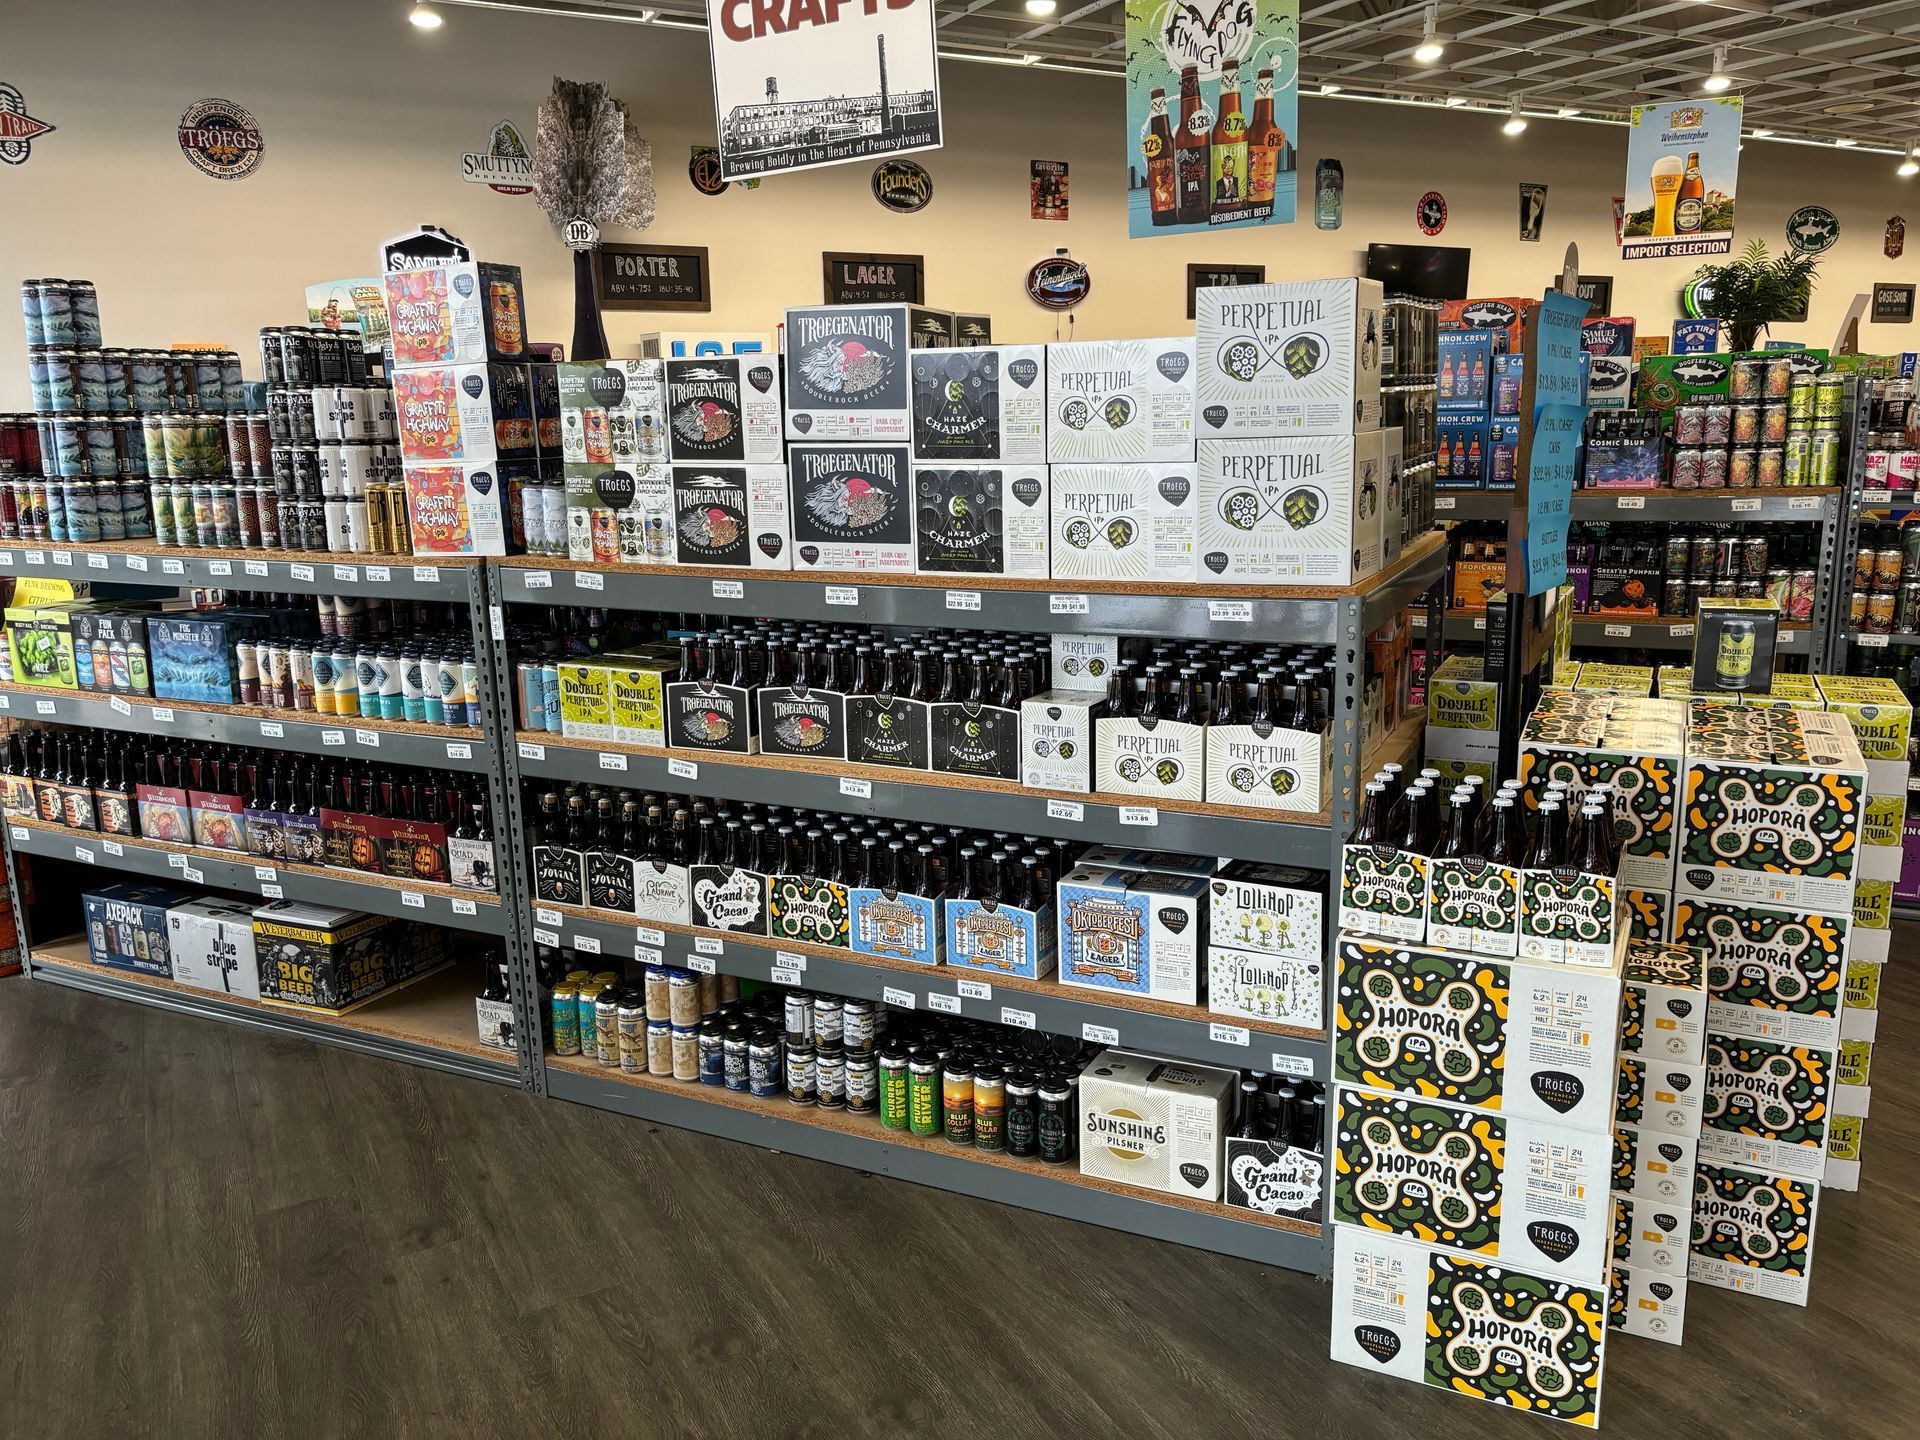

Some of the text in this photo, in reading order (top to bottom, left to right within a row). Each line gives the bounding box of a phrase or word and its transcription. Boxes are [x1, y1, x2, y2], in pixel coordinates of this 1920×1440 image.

[1167, 2, 1254, 66] FLYING DOG
[189, 104, 250, 128] INDEPENDENT
[6, 114, 38, 137] TRAIL
[184, 126, 260, 151] TRÖEGS
[1660, 130, 1709, 144] Weihenstephan
[730, 131, 932, 173] Brewing Boldly in the Heart of Pennsylvania
[191, 149, 218, 172] CRAFT
[218, 151, 256, 174] BREWERY
[1035, 162, 1065, 173] favorite
[880, 168, 927, 200] Founders
[1254, 205, 1271, 218] BEER
[570, 224, 590, 241] DB
[1626, 242, 1728, 259] IMPORT SELECTION
[615, 256, 680, 278] PORTER
[844, 264, 896, 286] LAGER
[396, 301, 438, 321] GRAFFITI
[1220, 299, 1325, 330] PERPETUAL
[1468, 303, 1514, 314] DOGFISH HEAD
[398, 317, 443, 336] HIGHWAY
[798, 314, 895, 350] TROEGENATOR
[1583, 328, 1618, 341] SAMUEL
[1676, 326, 1716, 336] FAT TIRE
[1264, 334, 1280, 345] IPA
[1585, 336, 1614, 345] ADAMS
[1679, 358, 1724, 371] DOGFISH HEAD
[1061, 370, 1134, 393] PERPETUAL
[670, 382, 738, 408] TROEGENATOR
[804, 384, 886, 404] DOUBLEBOCK BEER
[404, 400, 448, 418] GRAFFITI
[406, 416, 451, 434] HIGHWAY
[925, 416, 986, 434] CHARMER
[1590, 439, 1645, 447] COSMIC BLUR
[802, 454, 898, 487] TROEGENATOR
[1222, 452, 1325, 482] PERPETUAL
[1264, 486, 1280, 497] IPA
[415, 494, 455, 512] GRAFFITI
[676, 489, 745, 516] TROEGENATOR
[1064, 492, 1136, 514] PERPETUAL
[417, 510, 460, 528] HIGHWAY
[928, 530, 990, 549] CHARMER
[948, 530, 970, 538] HAZE
[1628, 568, 1660, 576] PUMPKIN
[98, 619, 112, 629] FUN
[179, 624, 190, 632] FOG
[98, 628, 115, 640] PACK
[172, 632, 200, 642] MONSTER
[1062, 642, 1108, 654] PERPETUAL
[1721, 646, 1752, 656] DOUBLE
[564, 679, 604, 697] DOUBLE
[616, 686, 656, 702] DOUBLE
[566, 694, 604, 708] PERPETUAL
[616, 700, 657, 712] PERPETUAL
[681, 696, 734, 720] TROEGENATOR
[578, 708, 592, 718] IPA
[630, 713, 644, 723] IPA
[772, 702, 830, 725] TROEGENATOR
[864, 736, 910, 753] CHARMER
[1117, 734, 1182, 754] PERPETUAL
[950, 745, 998, 762] CHARMER
[1051, 810, 1073, 818] $12.69
[1731, 807, 1806, 832] HOPORA
[1758, 831, 1775, 840] IPA
[451, 847, 474, 860] QUAD
[1362, 874, 1405, 893] HOPORA
[1720, 886, 1735, 894] HOPS
[703, 886, 744, 911] Grand
[106, 901, 143, 926] AXEPACK
[713, 904, 748, 920] Cacao
[870, 902, 913, 926] OKTOBERFEST
[170, 917, 182, 930] 15
[258, 920, 326, 944] WEYERBACHER
[1073, 910, 1137, 937] OKTOBERFEST
[212, 936, 237, 956] blue
[882, 936, 903, 944] LAGER
[206, 952, 238, 974] stripe
[1090, 951, 1120, 965] LAGER
[1719, 942, 1792, 970] HOPORA
[277, 962, 313, 984] BIG
[776, 974, 792, 982] $9.59
[278, 979, 315, 997] BEER
[1576, 994, 1588, 1003] 24
[1534, 1005, 1550, 1014] HOPS
[1378, 1007, 1460, 1042] HOPORA
[1535, 1015, 1549, 1024] MALT
[1214, 1034, 1238, 1042] $16.19
[1409, 1038, 1427, 1048] IPA
[1538, 1090, 1576, 1100] INDEPENDENT
[1710, 1073, 1779, 1100] HOPORA
[888, 1084, 896, 1118] MURREN
[896, 1078, 906, 1119] RIVER
[1546, 1096, 1572, 1105] BREWING
[947, 1118, 971, 1127] COLLAR
[950, 1112, 968, 1120] BLUE
[1087, 1112, 1166, 1144] SUNSHINE
[1106, 1136, 1144, 1152] PILSNER
[1244, 1166, 1298, 1190] Grand
[1376, 1152, 1457, 1188] HOPORA
[1256, 1184, 1304, 1202] Cacao
[1406, 1184, 1424, 1193] IPA
[1694, 1200, 1764, 1228] HOPORA
[1468, 1318, 1553, 1358] HOPORA
[1499, 1351, 1518, 1362] IPA
